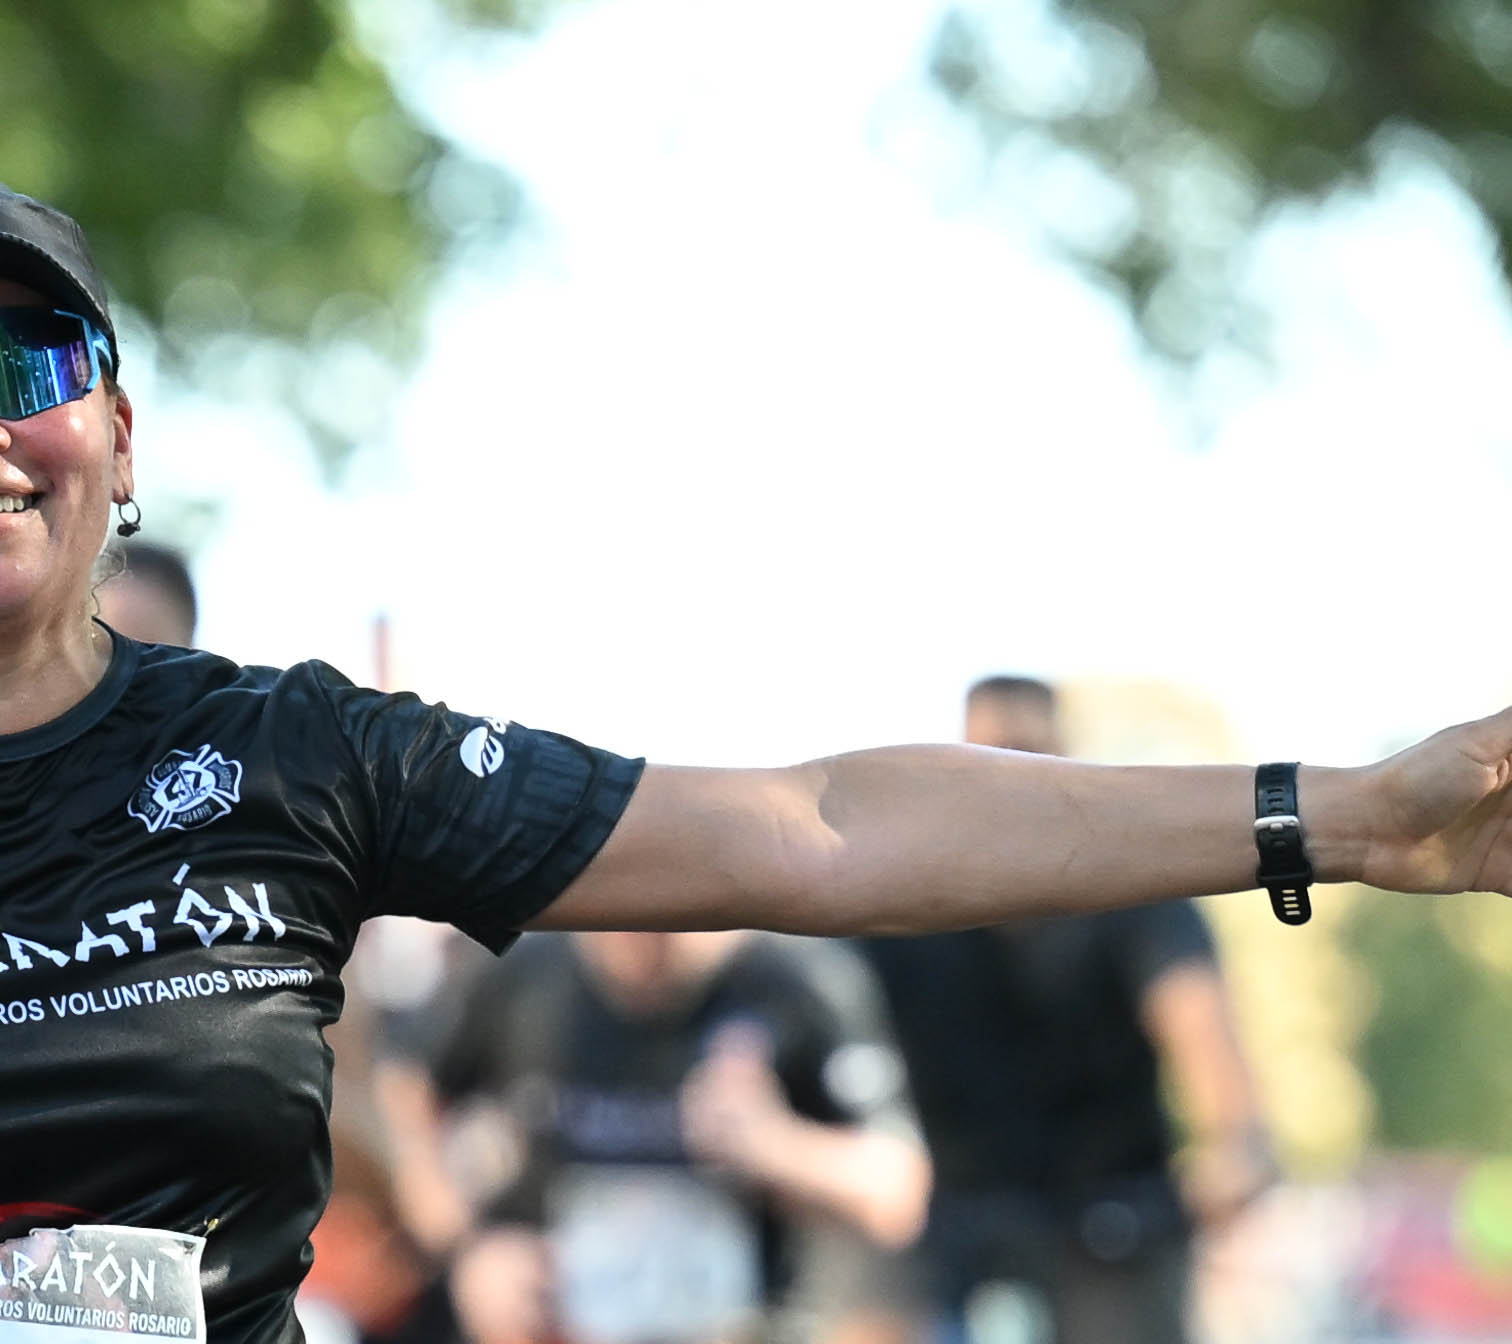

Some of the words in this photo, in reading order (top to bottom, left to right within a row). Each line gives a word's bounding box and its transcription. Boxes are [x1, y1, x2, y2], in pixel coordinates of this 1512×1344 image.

[50, 974, 230, 1018] VOLUNTARIOS
[232, 968, 313, 990] ROSARIO
[28, 1302, 125, 1329] VOLUNTARIOS
[129, 1312, 191, 1336] ROSARIO
